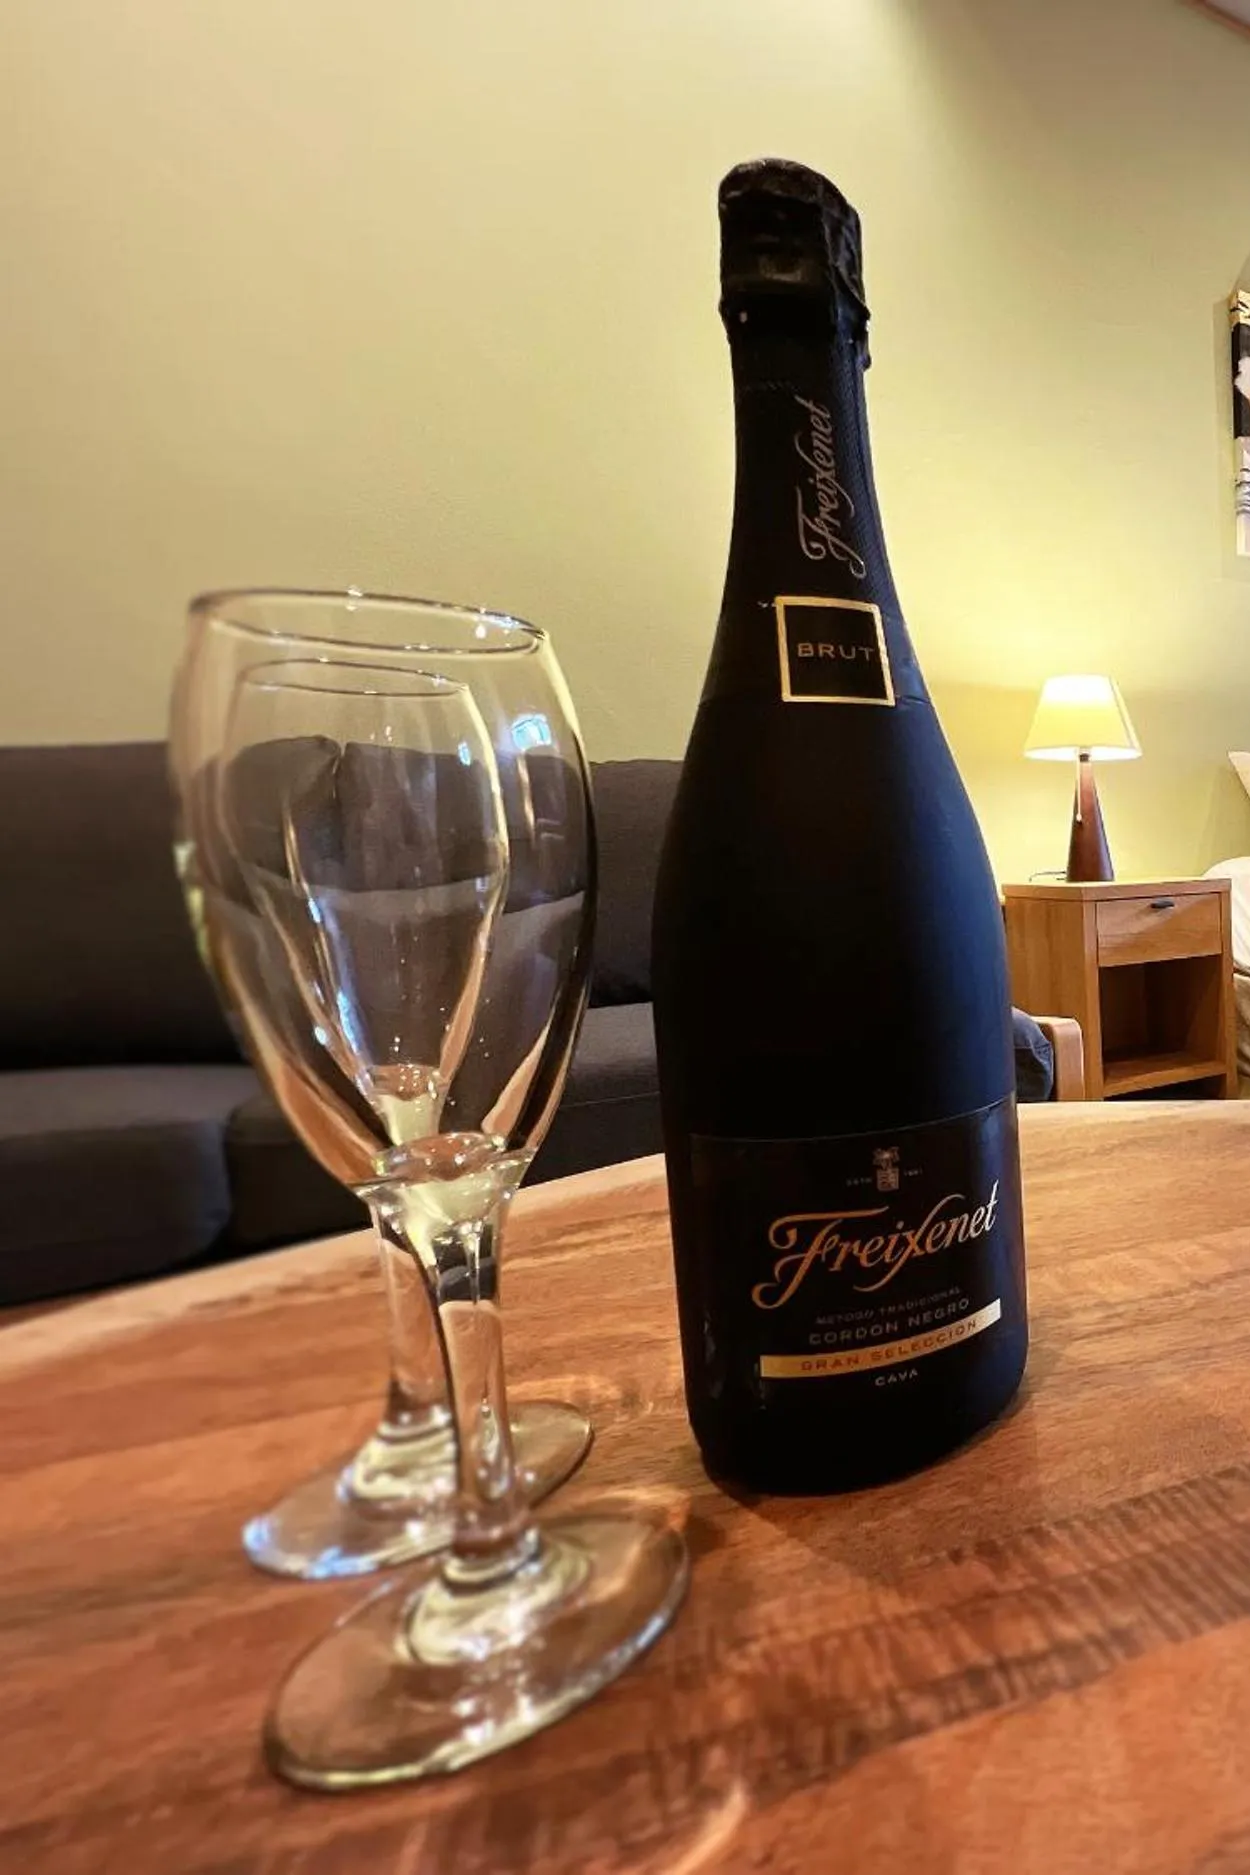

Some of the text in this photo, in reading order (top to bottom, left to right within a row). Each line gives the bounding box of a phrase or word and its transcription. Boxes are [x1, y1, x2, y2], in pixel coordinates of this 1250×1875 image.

[795, 395, 866, 579] Freixenet
[797, 642, 874, 661] BRUT
[751, 1179, 999, 1309] Freixenet
[808, 1298, 970, 1346] CORDON NEGRO
[802, 1355, 859, 1371] GRAN
[874, 1368, 919, 1387] CAVA
